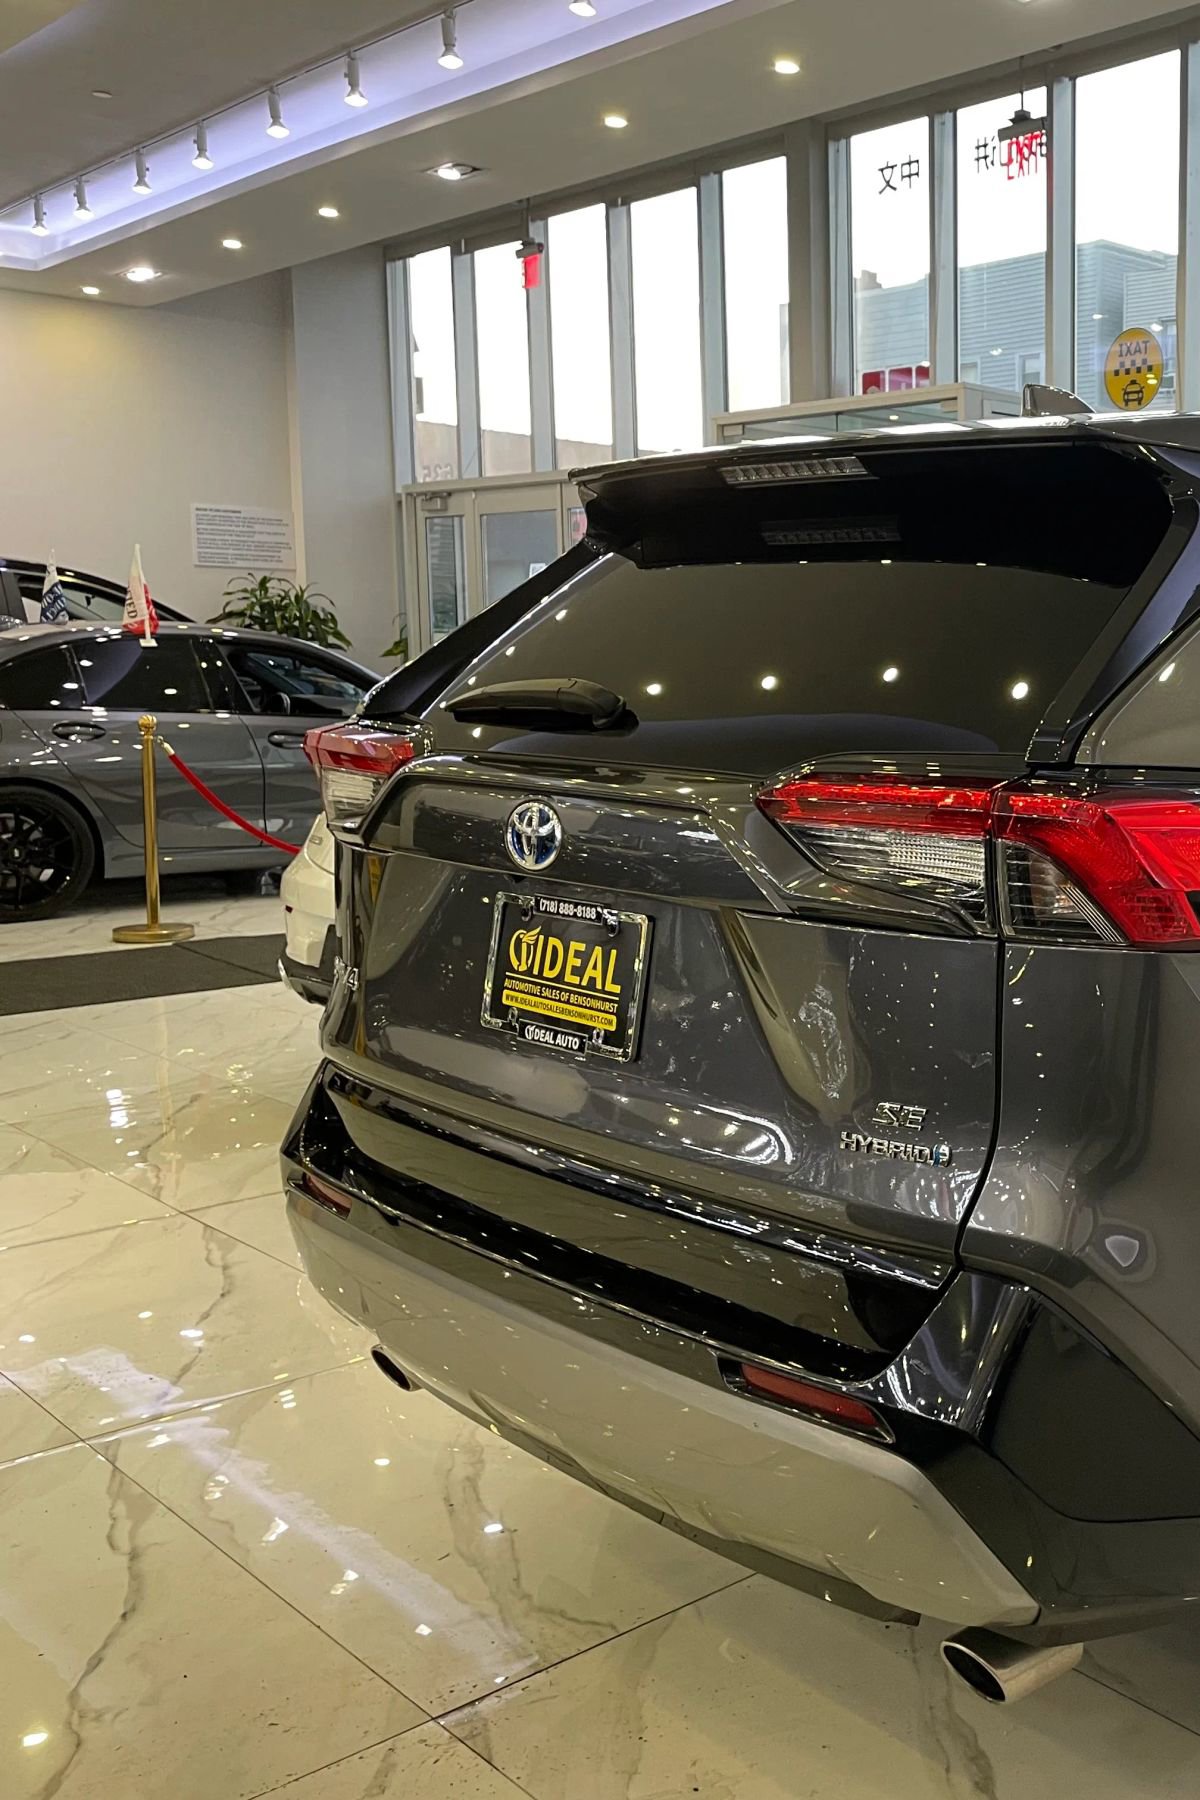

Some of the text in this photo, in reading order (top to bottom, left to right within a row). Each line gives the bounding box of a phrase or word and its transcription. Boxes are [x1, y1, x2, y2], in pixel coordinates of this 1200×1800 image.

[539, 898, 597, 920] (718) 888-8188
[532, 934, 621, 994] IDEAL
[504, 977, 619, 1014] AUTOMOTIVE SALES OF BENSONHURST
[555, 1033, 580, 1050] AUTO
[872, 1102, 928, 1131] SE
[840, 1131, 931, 1164] HYBRID
